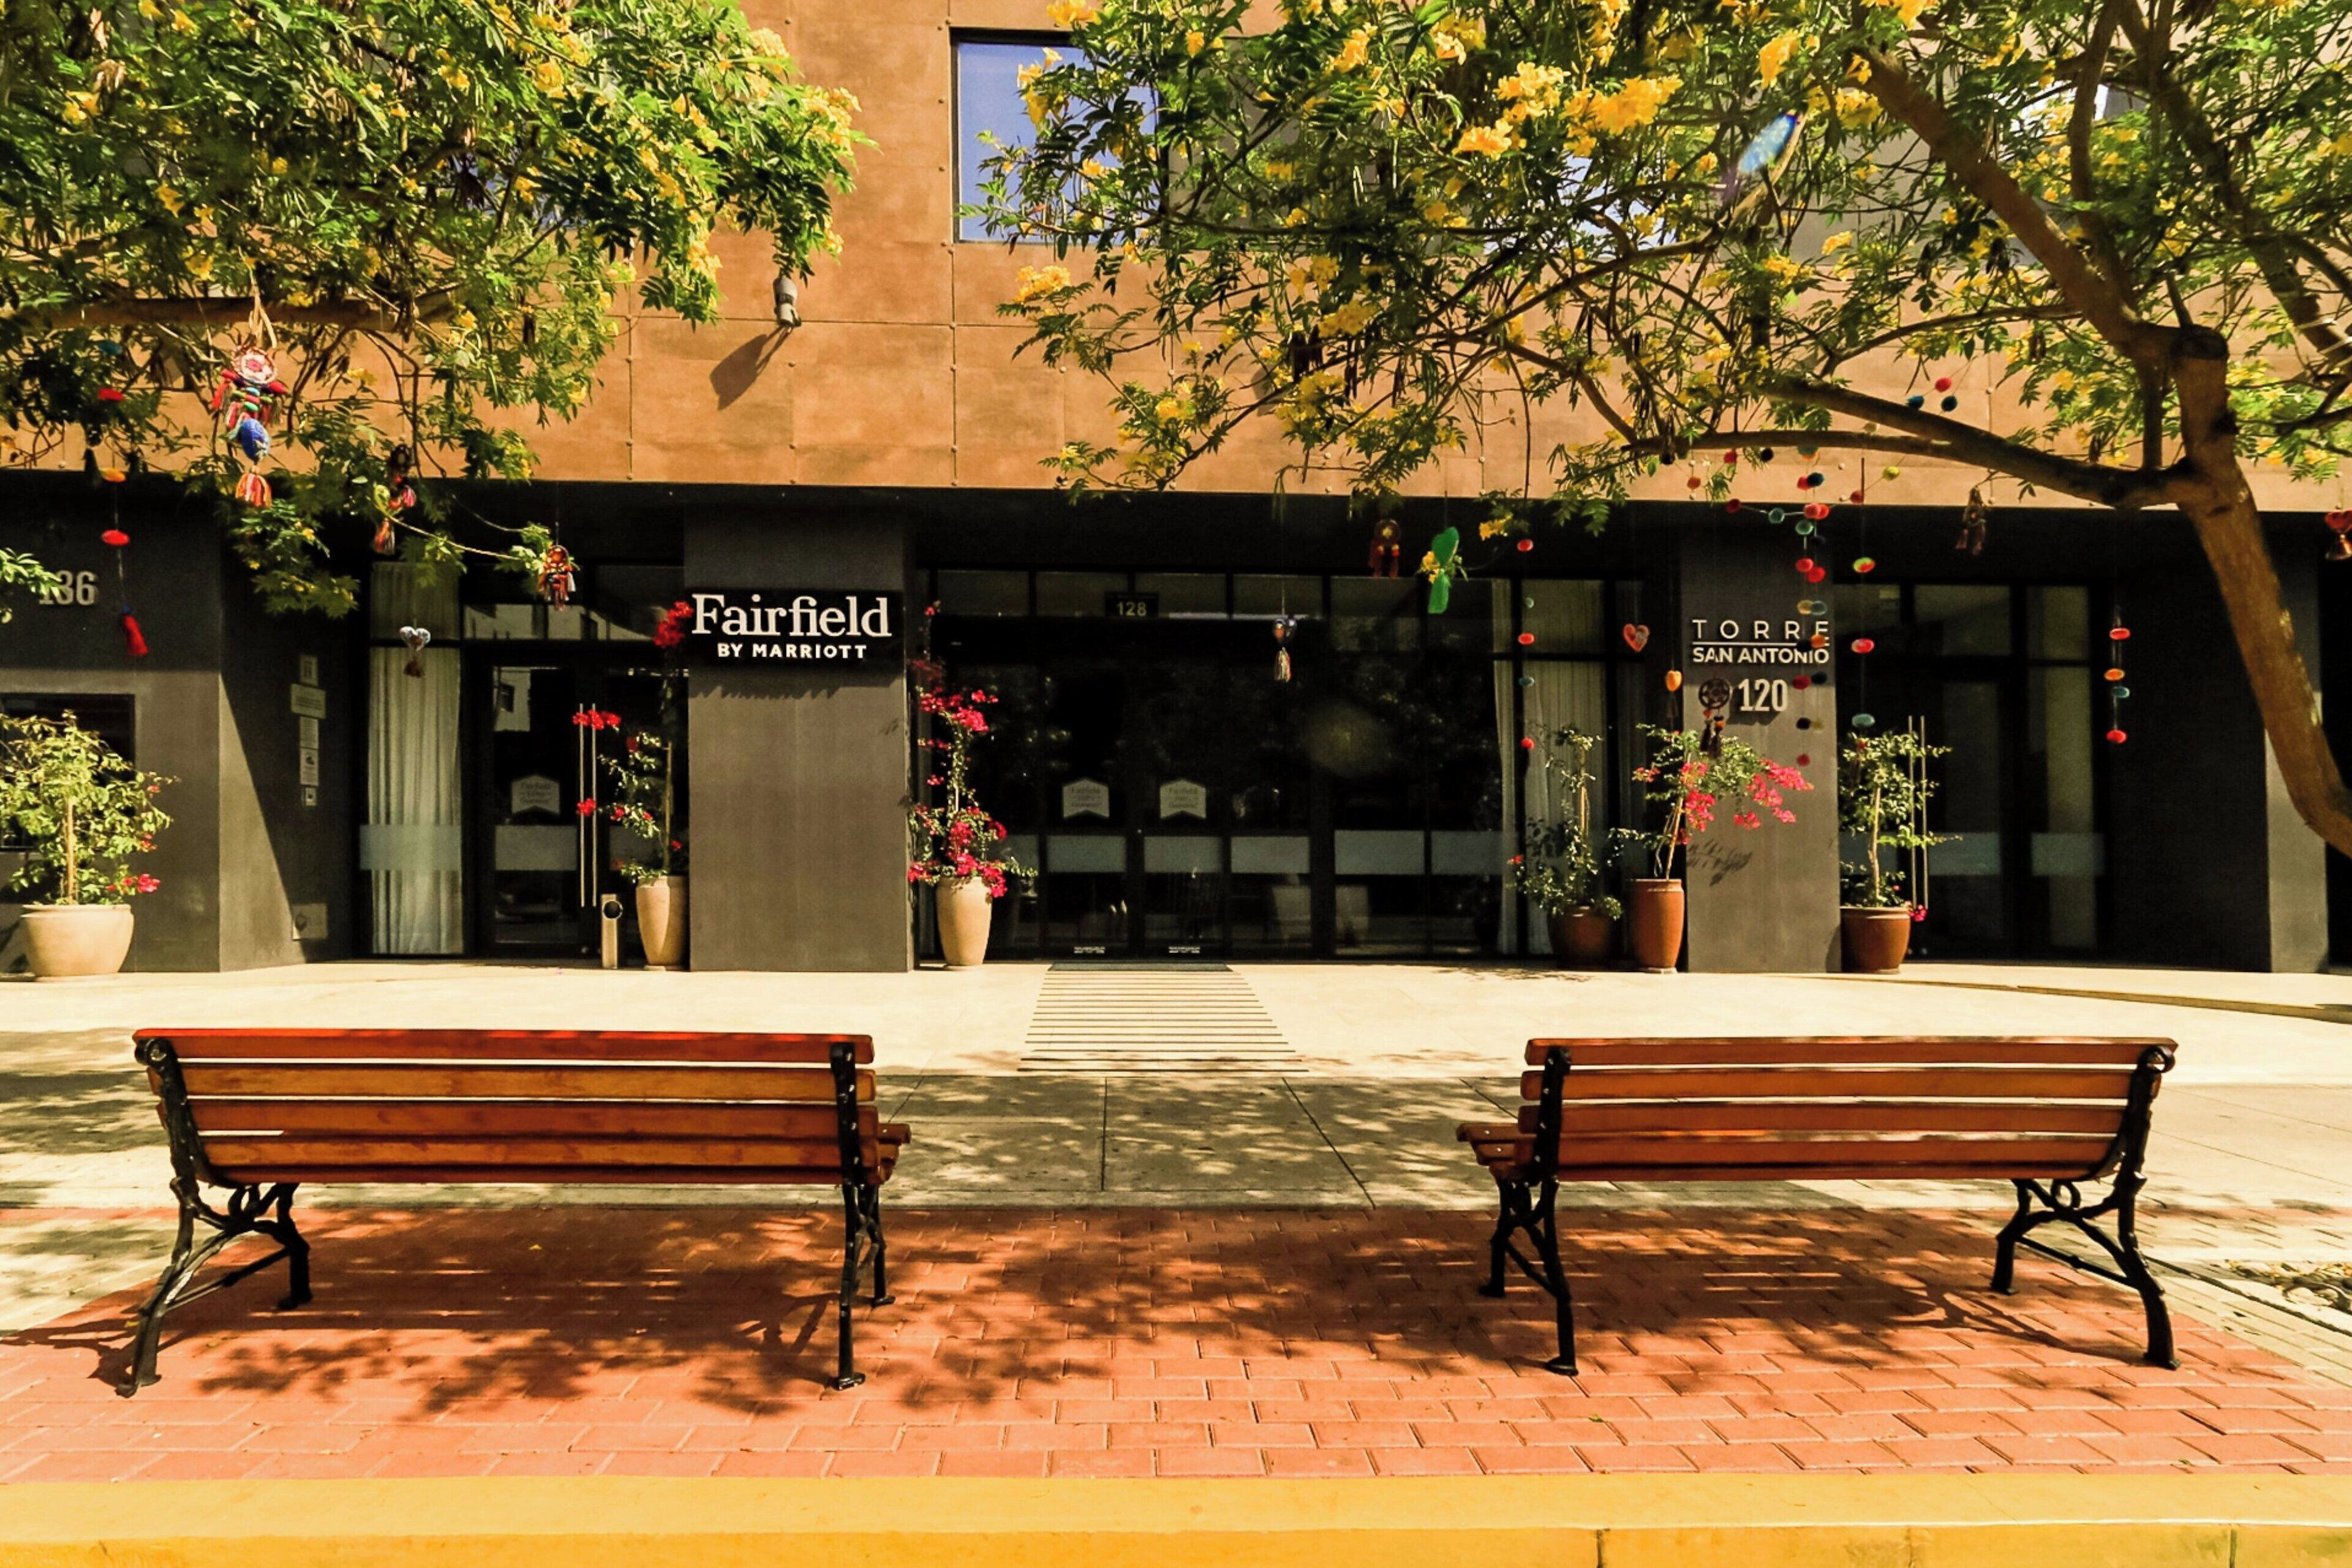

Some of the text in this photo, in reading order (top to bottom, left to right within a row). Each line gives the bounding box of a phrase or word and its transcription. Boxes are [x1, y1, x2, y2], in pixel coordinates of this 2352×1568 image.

[692, 593, 892, 638] Fairfield
[1117, 601, 1147, 617] 128
[1692, 619, 1830, 640] TORRE
[717, 643, 867, 659] BY MARRIOTT
[1692, 647, 1830, 664] SAN ANTONIO
[1738, 678, 1788, 712] 120
